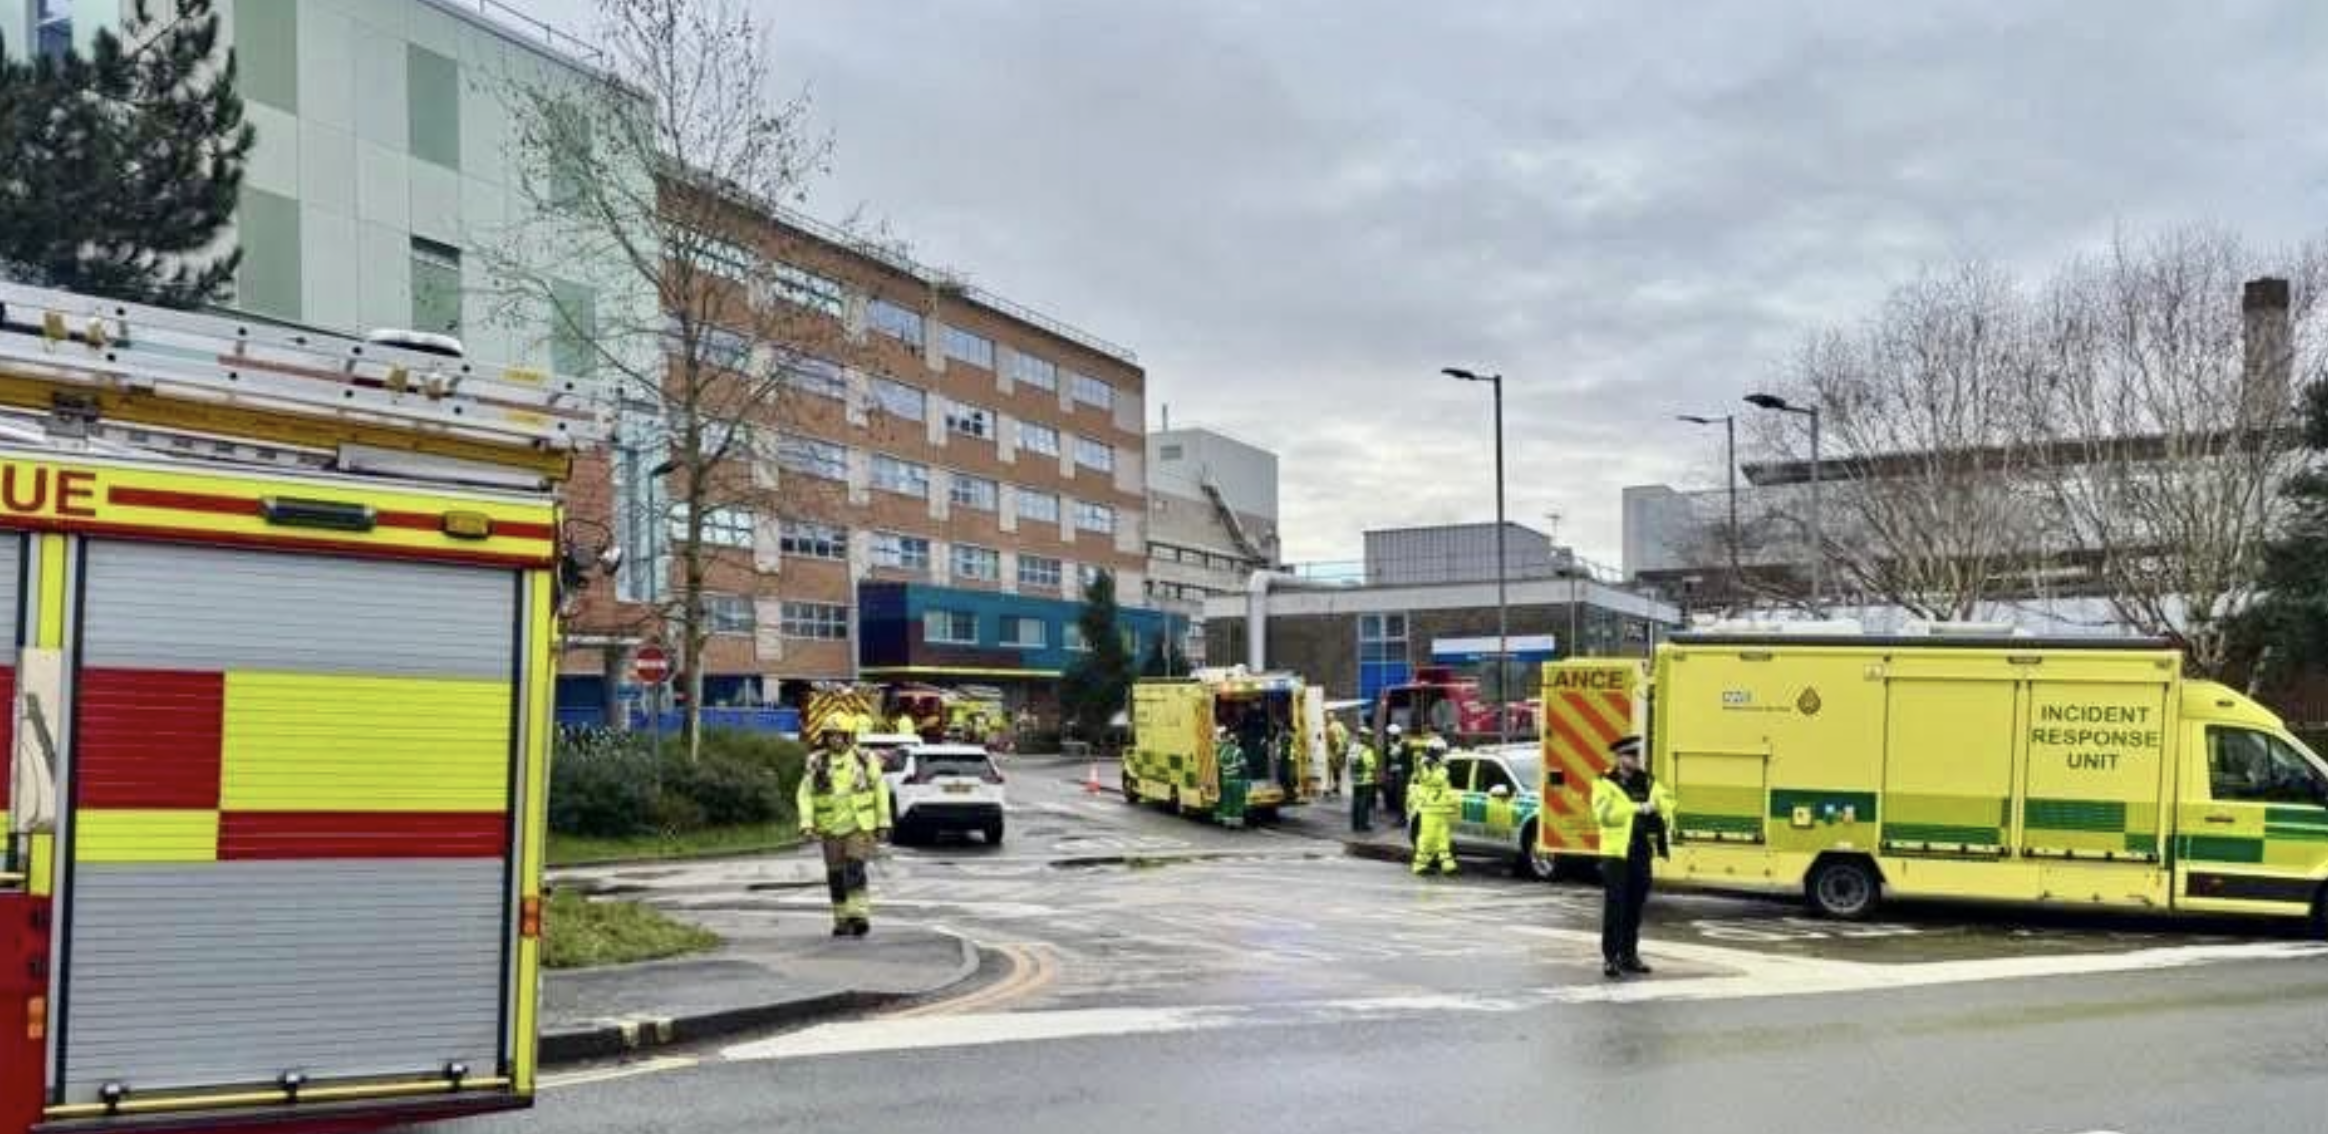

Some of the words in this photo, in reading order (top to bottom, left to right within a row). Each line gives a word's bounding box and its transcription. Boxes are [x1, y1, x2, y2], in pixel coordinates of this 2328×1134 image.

[3, 464, 96, 516] UE
[2041, 705, 2150, 722] INCIDENT
[2031, 729, 2160, 746] RESPONSE
[2067, 752, 2120, 770] UNIT
